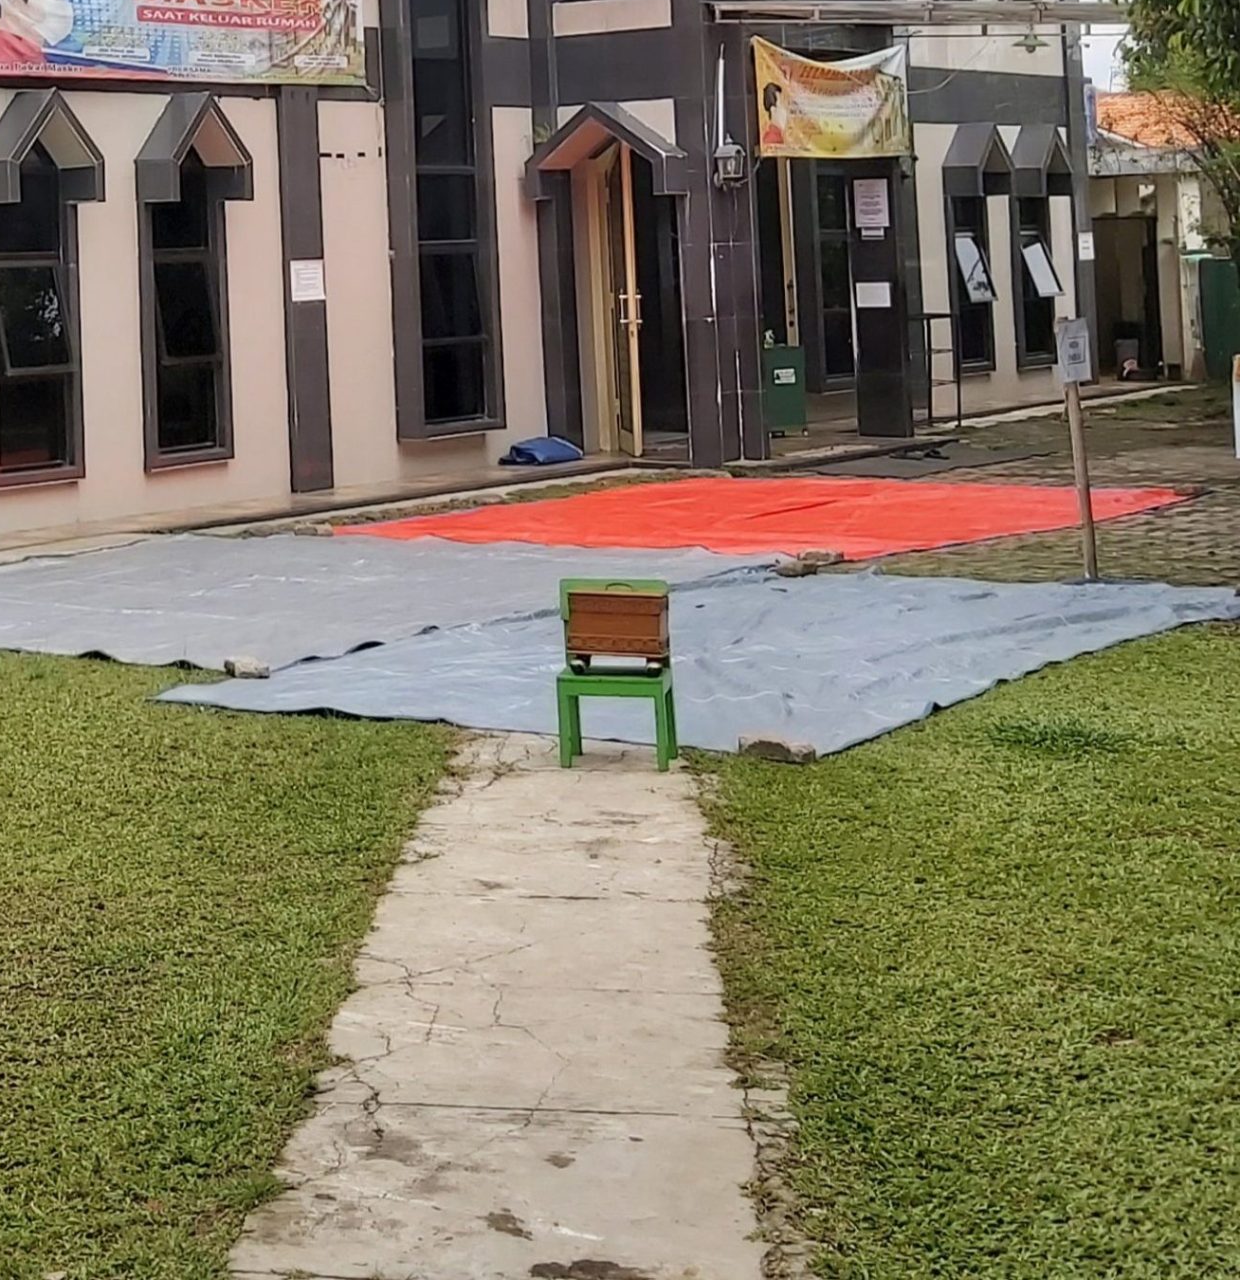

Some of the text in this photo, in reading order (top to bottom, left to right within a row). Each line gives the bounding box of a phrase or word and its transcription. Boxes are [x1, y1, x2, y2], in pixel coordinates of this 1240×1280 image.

[143, 9, 317, 29] SAAT KELUAR RUMAH
